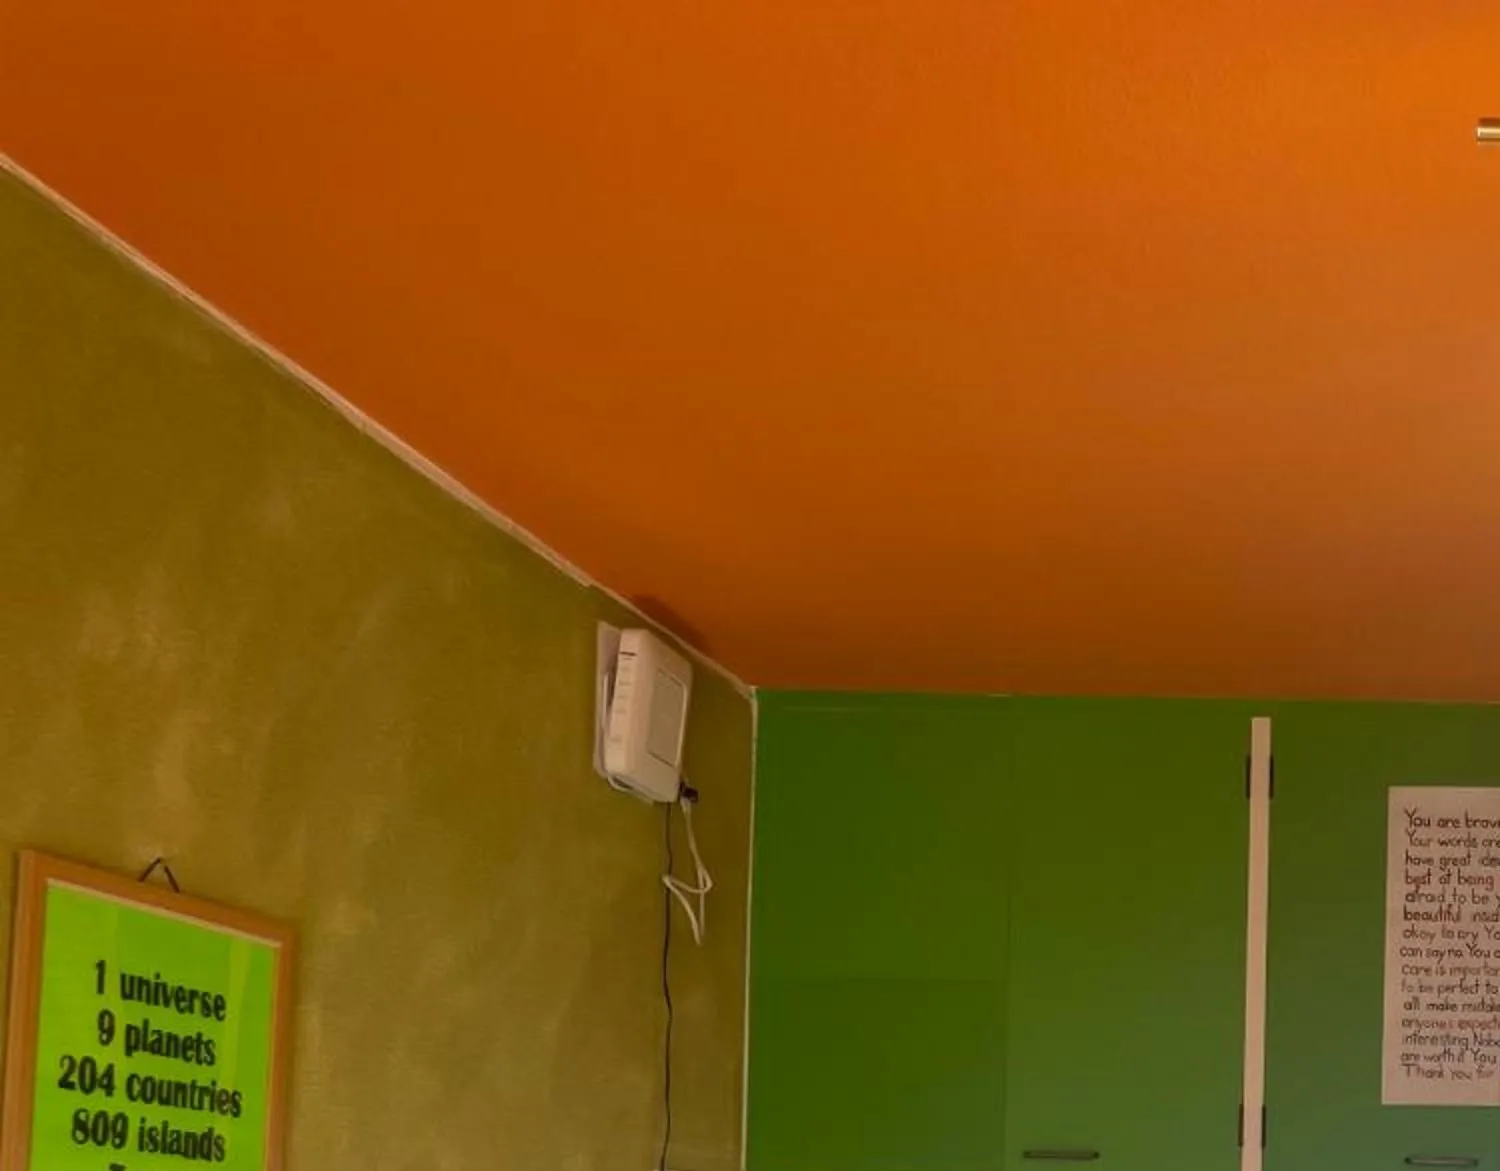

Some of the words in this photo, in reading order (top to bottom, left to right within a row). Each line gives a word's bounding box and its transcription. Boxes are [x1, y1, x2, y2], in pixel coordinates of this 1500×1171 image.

[1404, 807, 1431, 828] You
[1437, 818, 1461, 828] are
[1405, 828, 1432, 846] Your
[1438, 832, 1478, 848] words
[1405, 848, 1434, 865] have
[1439, 850, 1471, 871] great
[1405, 868, 1431, 884] best
[1439, 868, 1452, 884] at
[1457, 868, 1494, 891] being
[1452, 888, 1467, 904] to
[1471, 888, 1491, 905] be
[1403, 924, 1436, 944] okay
[1441, 924, 1455, 939] to
[1399, 946, 1423, 958] can
[1426, 948, 1446, 965] say
[1466, 942, 1492, 958] You
[1435, 965, 1446, 976] is
[95, 959, 107, 995] 1
[119, 972, 227, 1022] universe
[1402, 978, 1414, 992] to
[1418, 978, 1434, 993] be
[1437, 978, 1480, 998] perfect
[1485, 979, 1499, 994] to
[1403, 996, 1421, 1011] all
[1426, 996, 1458, 1012] make
[97, 1008, 116, 1047] 9
[124, 1018, 217, 1067] planets
[1401, 1053, 1421, 1063] are
[1423, 1048, 1455, 1063] worth
[1470, 1048, 1497, 1064] You
[1400, 1062, 1445, 1078] Thank
[1450, 1069, 1473, 1081] you
[1476, 1064, 1496, 1079] for
[57, 1054, 116, 1098] 204
[125, 1072, 243, 1119] countries
[70, 1107, 130, 1150] 809
[137, 1116, 227, 1163] islands
